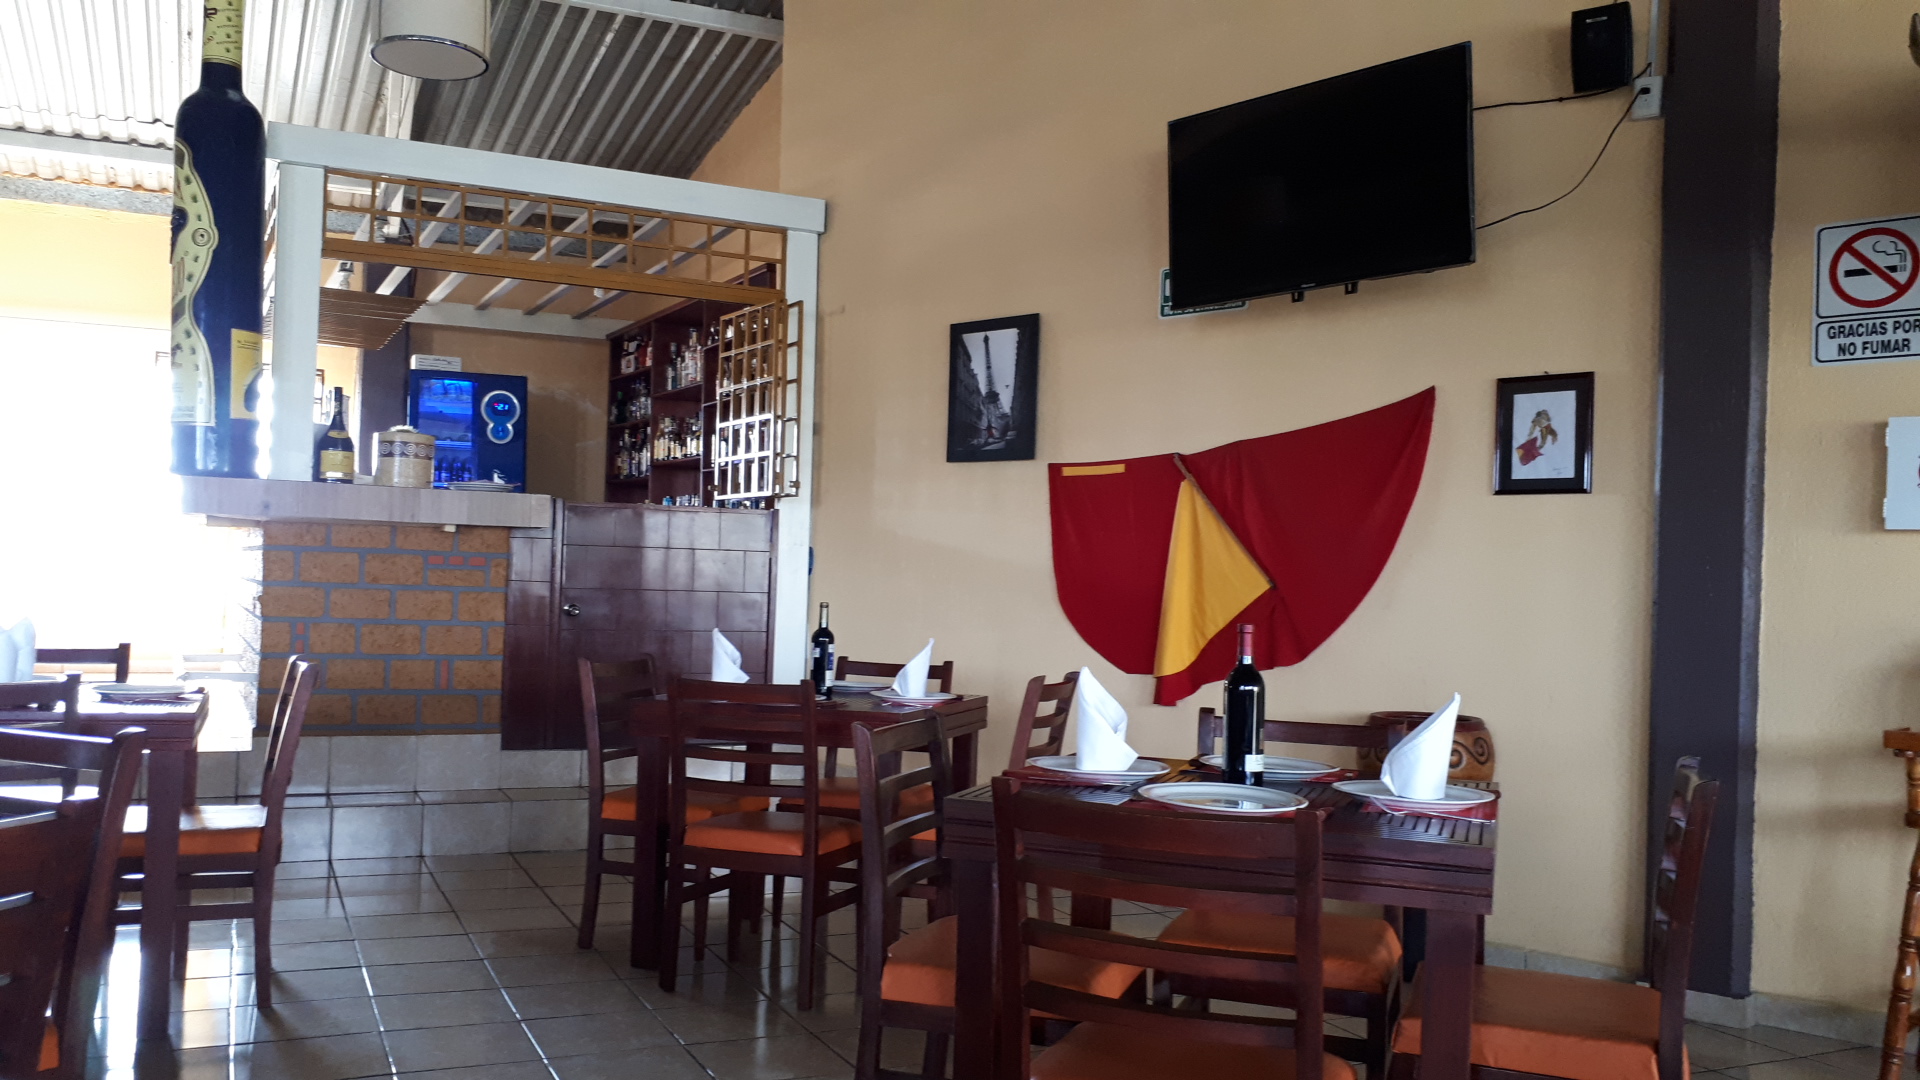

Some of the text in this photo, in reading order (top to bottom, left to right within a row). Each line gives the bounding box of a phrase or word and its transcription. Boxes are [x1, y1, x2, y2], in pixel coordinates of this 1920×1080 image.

[1827, 319, 1920, 339] GRACIAS POR
[1838, 338, 1911, 356] NO FUMAR
